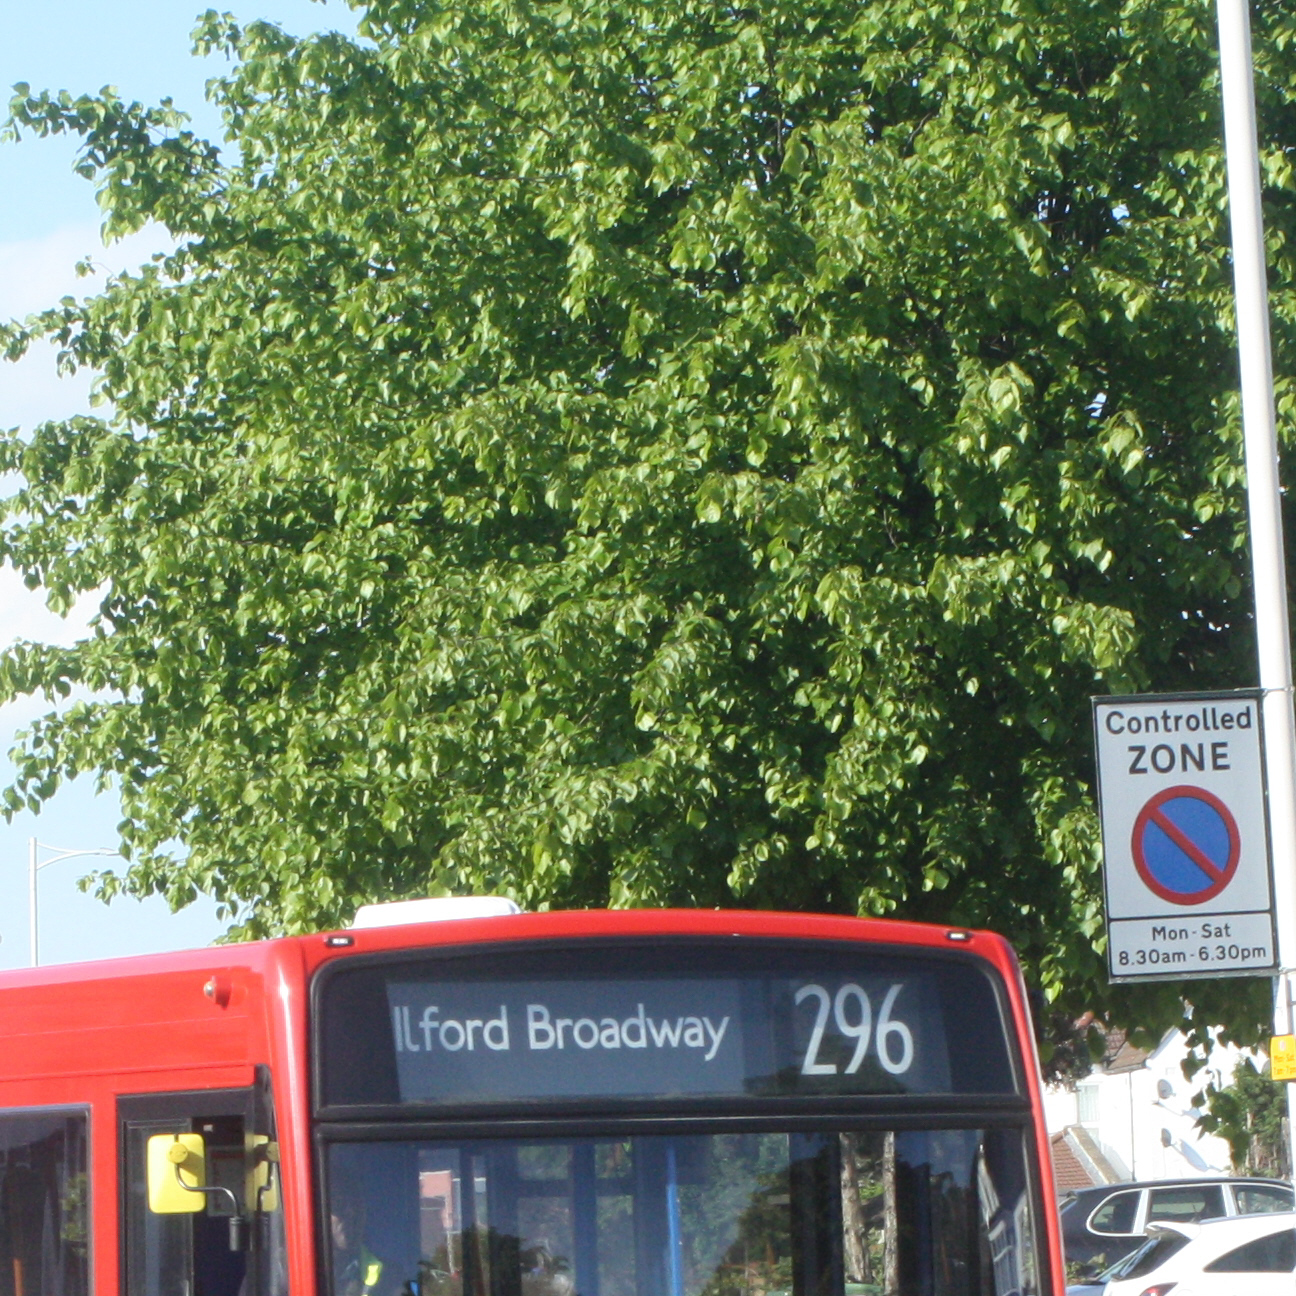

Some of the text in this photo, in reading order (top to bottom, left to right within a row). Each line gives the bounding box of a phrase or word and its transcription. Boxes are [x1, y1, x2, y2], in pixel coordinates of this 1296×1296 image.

[1105, 706, 1252, 734] Controlled
[1127, 742, 1231, 775] ZONE
[394, 983, 914, 1075] Ilford Broadway 296
